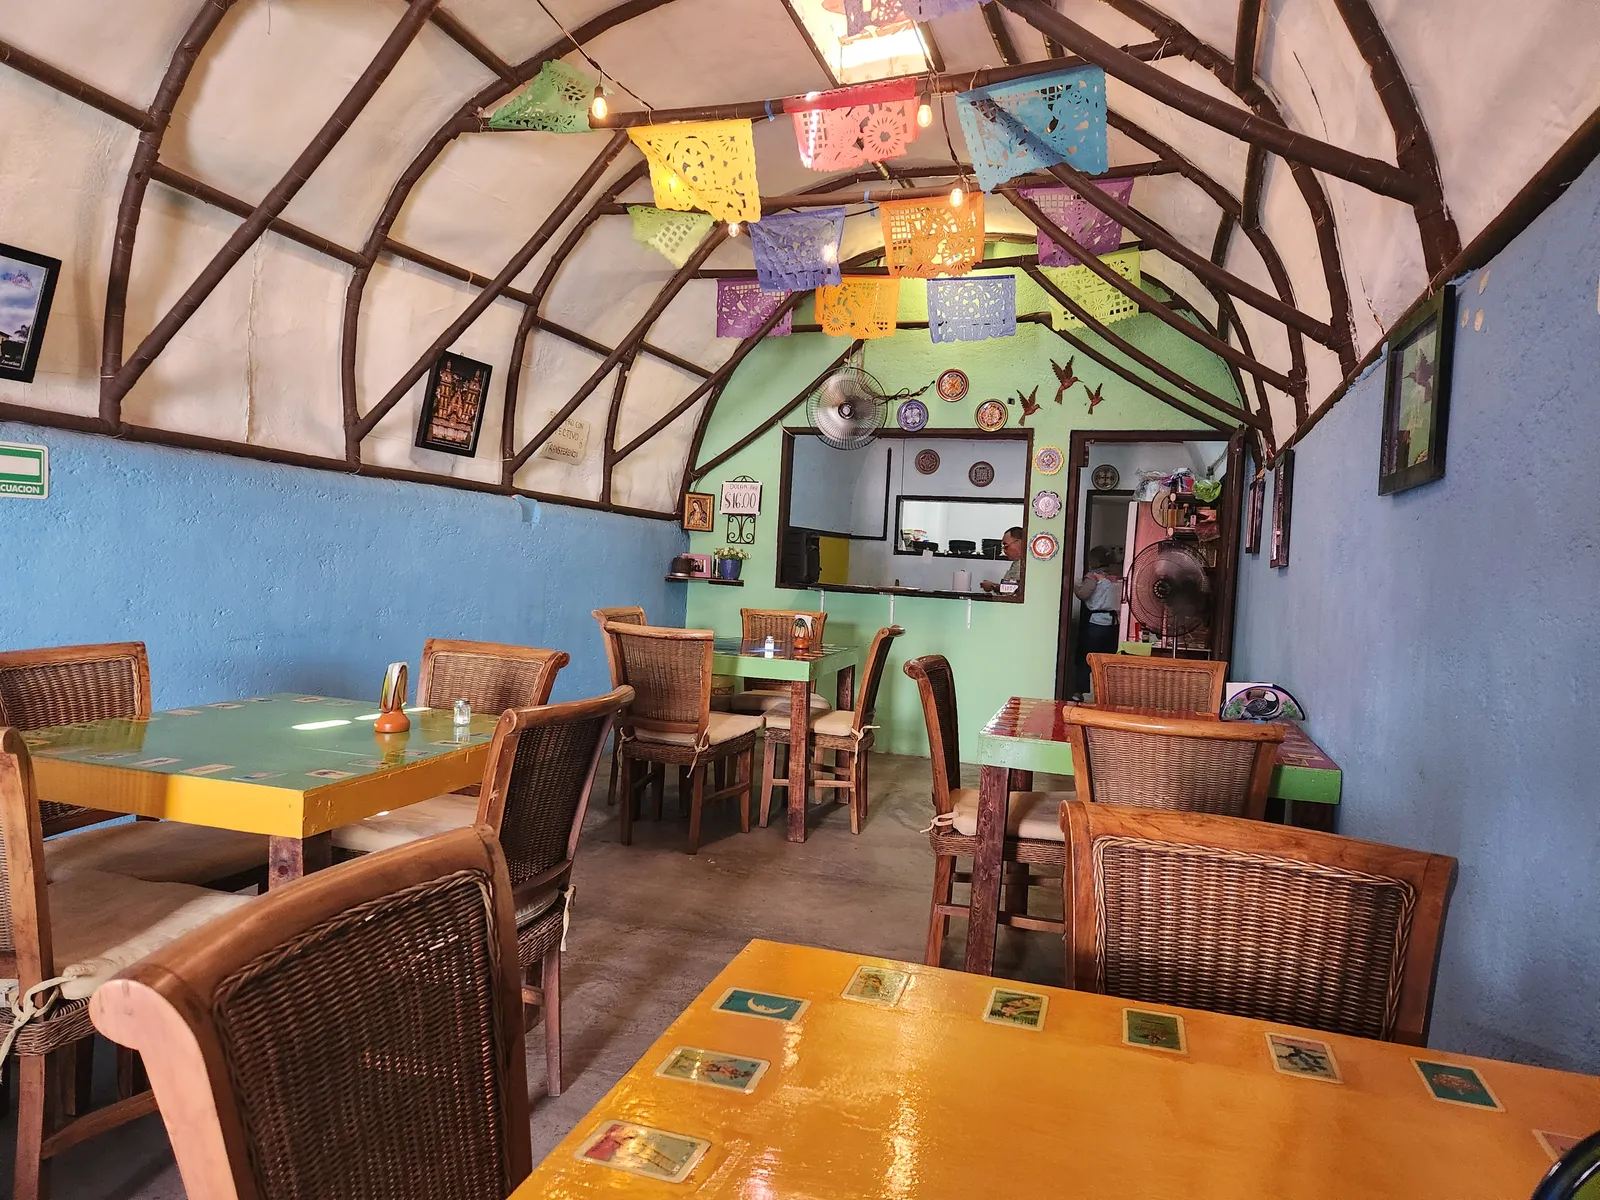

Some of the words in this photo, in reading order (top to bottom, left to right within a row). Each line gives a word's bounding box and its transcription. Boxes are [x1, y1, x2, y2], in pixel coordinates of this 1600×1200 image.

[554, 427, 580, 442] ECTIVO
[0, 483, 40, 494] CUACION
[724, 491, 757, 509] $16.00
